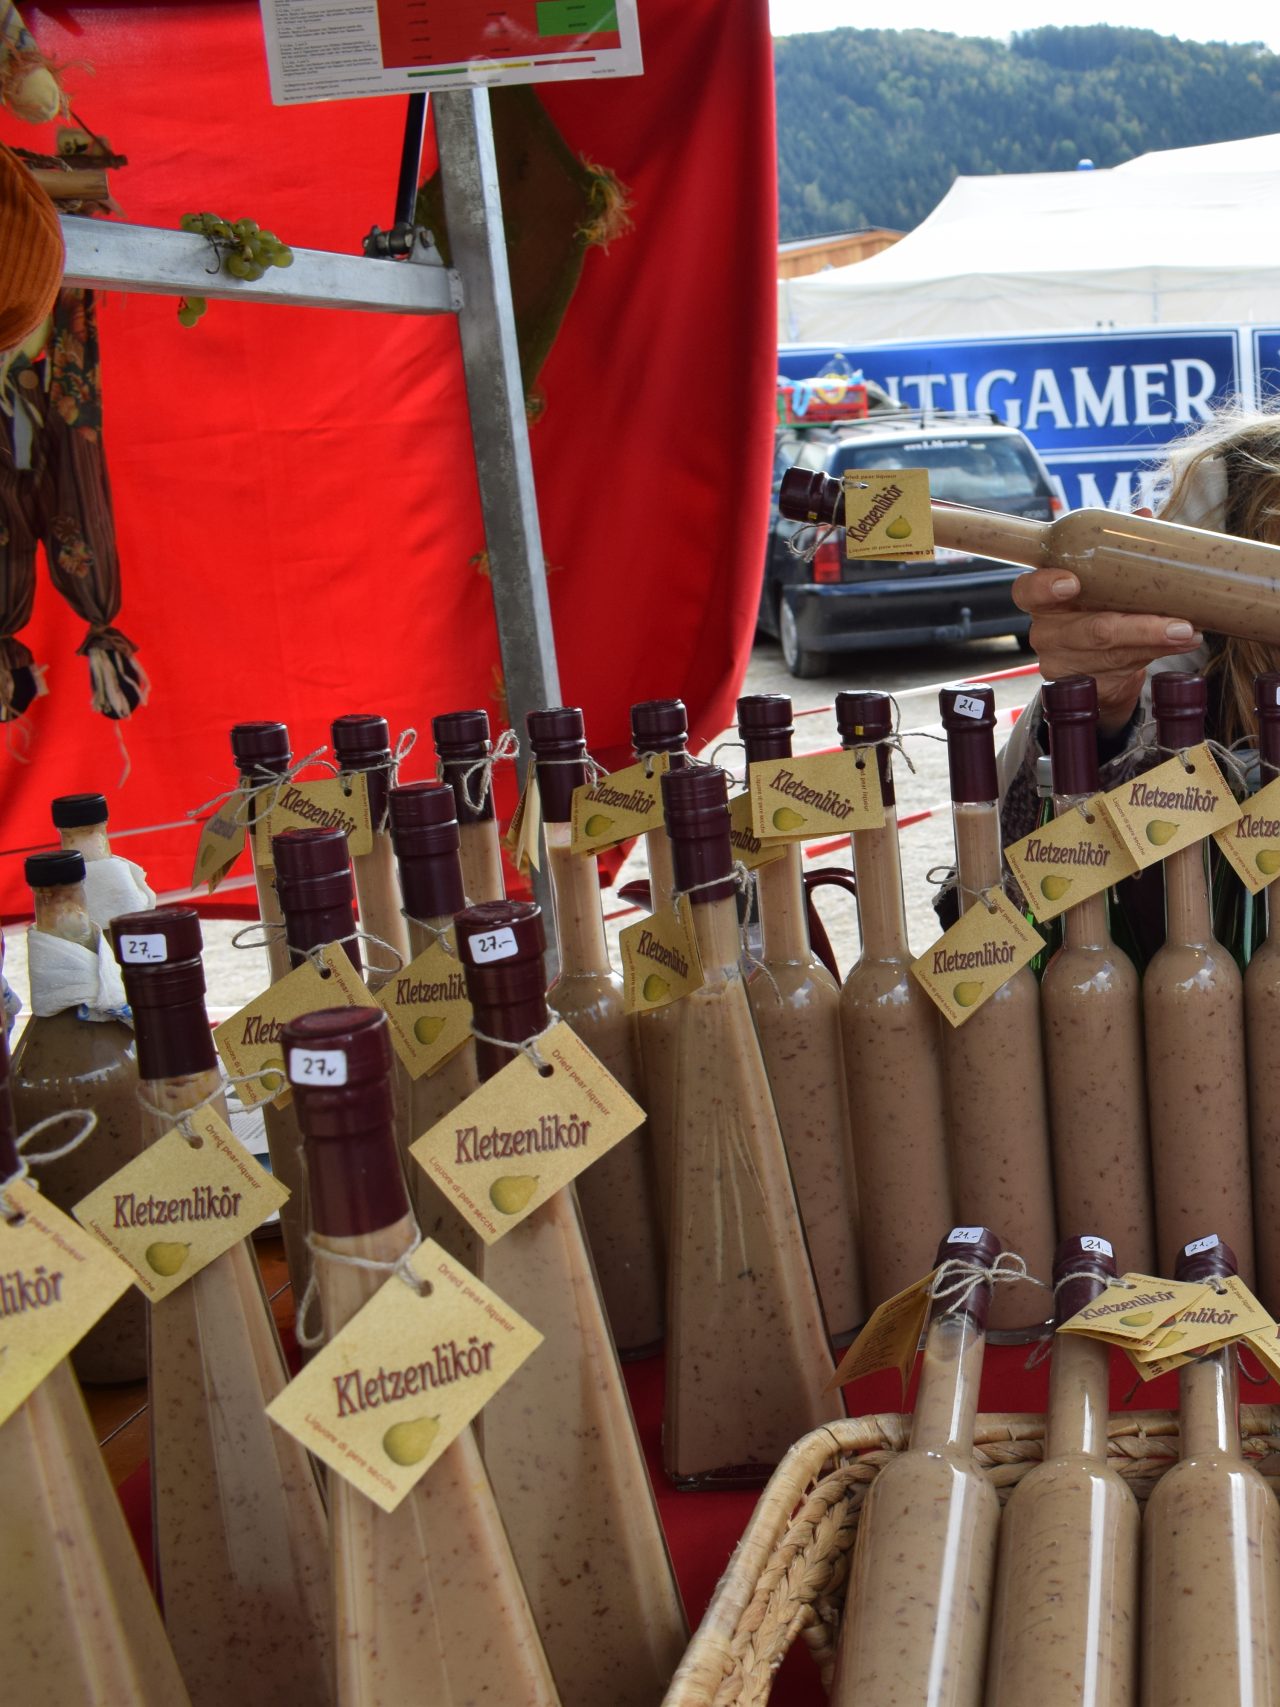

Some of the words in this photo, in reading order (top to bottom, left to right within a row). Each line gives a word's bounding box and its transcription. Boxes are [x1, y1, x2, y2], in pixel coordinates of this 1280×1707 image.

[885, 358, 1216, 430] TIGAMER
[847, 485, 903, 542] Kletzenlikör
[769, 769, 854, 819] Kletzenlikör
[1129, 783, 1219, 813] Kletzenlikör
[1024, 839, 1111, 867] Kletzenlikör
[933, 940, 1016, 974] Kletzenlikör
[395, 973, 467, 1004] Kletzenlik
[552, 1050, 572, 1073] Dried
[569, 1070, 586, 1090] pear
[584, 1087, 611, 1117] liqueur
[205, 1123, 223, 1148] Dried
[222, 1146, 239, 1164] pear
[234, 1160, 262, 1189] liqueur
[455, 1113, 592, 1165] Kletzenlikör
[113, 1186, 242, 1228] Kletzenlikör
[429, 1157, 453, 1185] Liquore
[458, 1191, 476, 1210] pere
[473, 1207, 497, 1234] secche
[438, 1263, 462, 1288] Dried
[462, 1286, 485, 1306] pear
[483, 1304, 515, 1333] liqueur
[1079, 1290, 1176, 1319] Kletzenlikör
[1181, 1308, 1238, 1325] nlikör
[333, 1335, 495, 1418] Kletzenlikör
